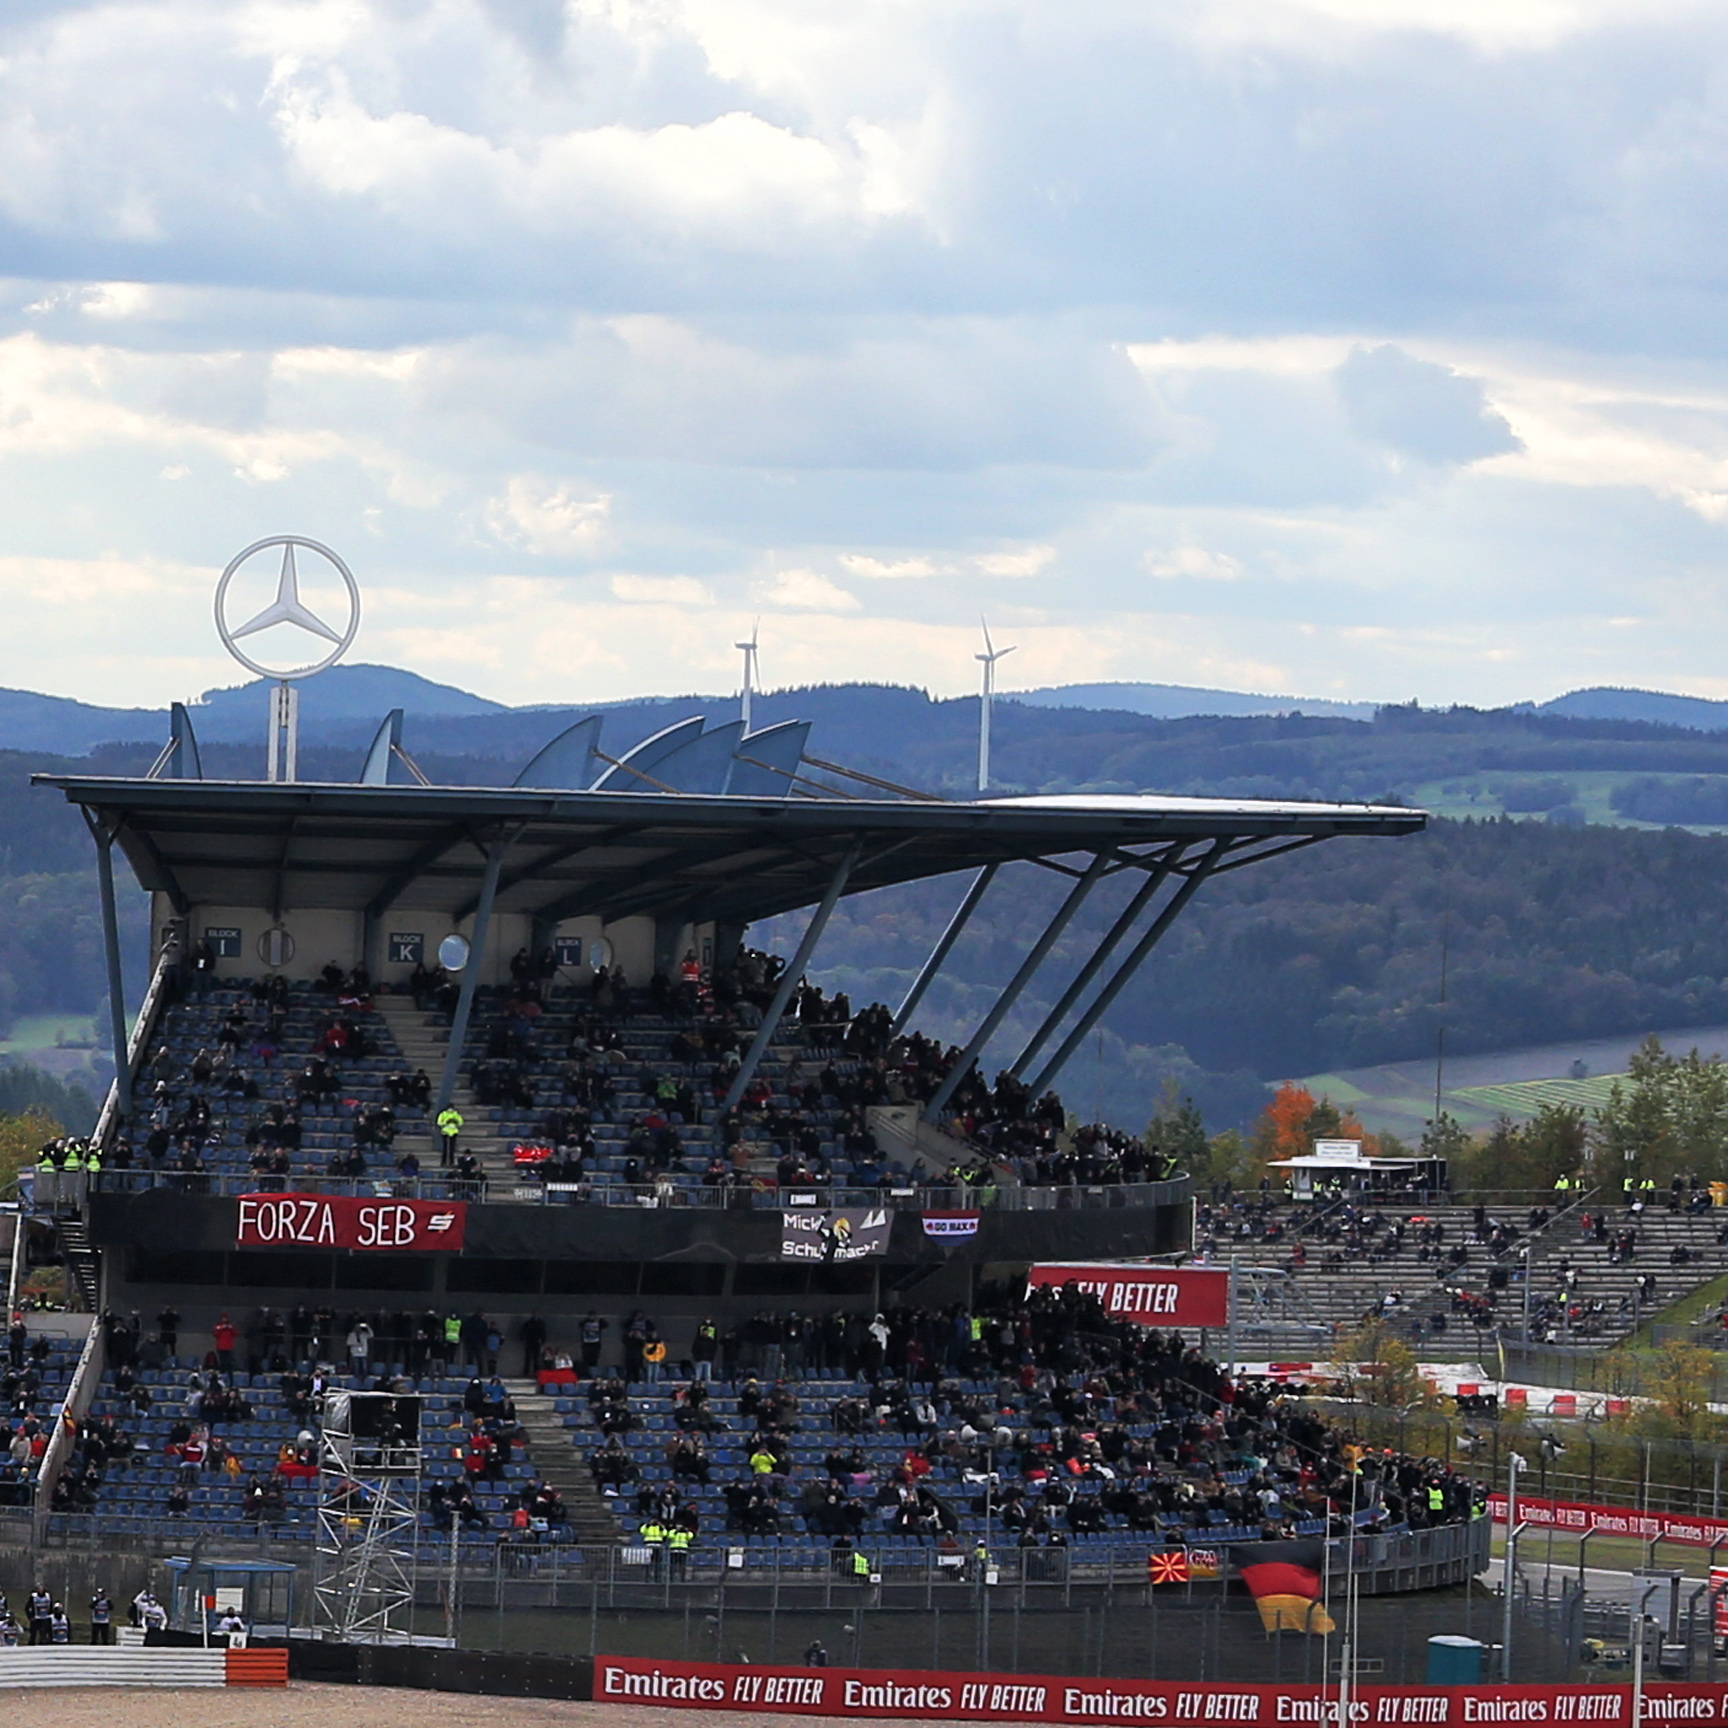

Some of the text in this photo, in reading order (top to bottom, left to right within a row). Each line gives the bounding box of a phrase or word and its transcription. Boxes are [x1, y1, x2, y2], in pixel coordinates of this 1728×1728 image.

[208, 929, 239, 938] BLOCK
[392, 934, 422, 944] BLOCK
[399, 944, 414, 961] K
[562, 948, 573, 965] L
[237, 1200, 417, 1246] FORZA SEB
[1109, 1282, 1179, 1313] BETTER
[1590, 1511, 1628, 1531] Emirates
[1664, 1519, 1702, 1540] Emirates
[605, 1666, 824, 1705] Emirates FLY BETTER
[844, 1680, 1046, 1713] Emirates FLY BETTER
[1064, 1688, 1259, 1721] Emirates FLY BETTER
[1276, 1695, 1448, 1723] Emiraes FLY BETTER
[1464, 1694, 1622, 1722] Emirates FLY BETTER
[1639, 1692, 1715, 1719] Emirates
